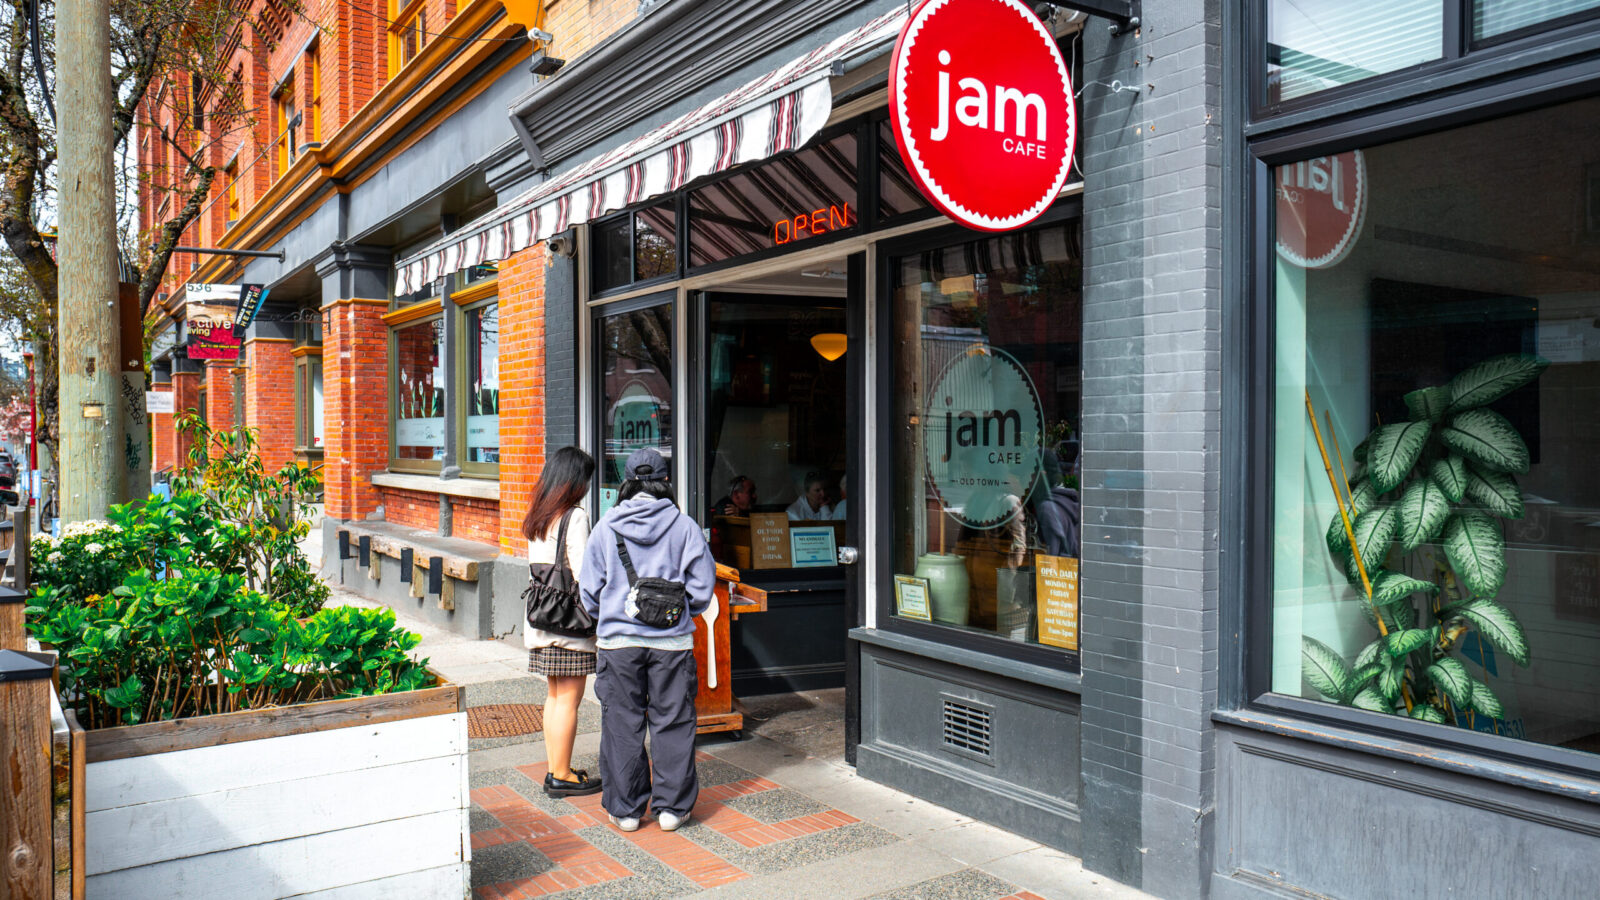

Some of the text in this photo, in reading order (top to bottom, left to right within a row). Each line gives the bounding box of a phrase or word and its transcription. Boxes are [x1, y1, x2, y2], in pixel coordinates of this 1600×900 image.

[930, 49, 1047, 142] jam
[1002, 138, 1047, 160] CAFE
[774, 201, 849, 245] OPEN
[187, 283, 212, 293] 536
[240, 291, 260, 327] HEALTH
[187, 327, 211, 337] living
[619, 411, 653, 453] jam
[941, 396, 1022, 463] jam
[988, 452, 1022, 465] CAFE
[960, 478, 1000, 487] OLD TOWN
[1040, 567, 1078, 579] OPEN DAILY
[1044, 579, 1067, 589] MONDAY
